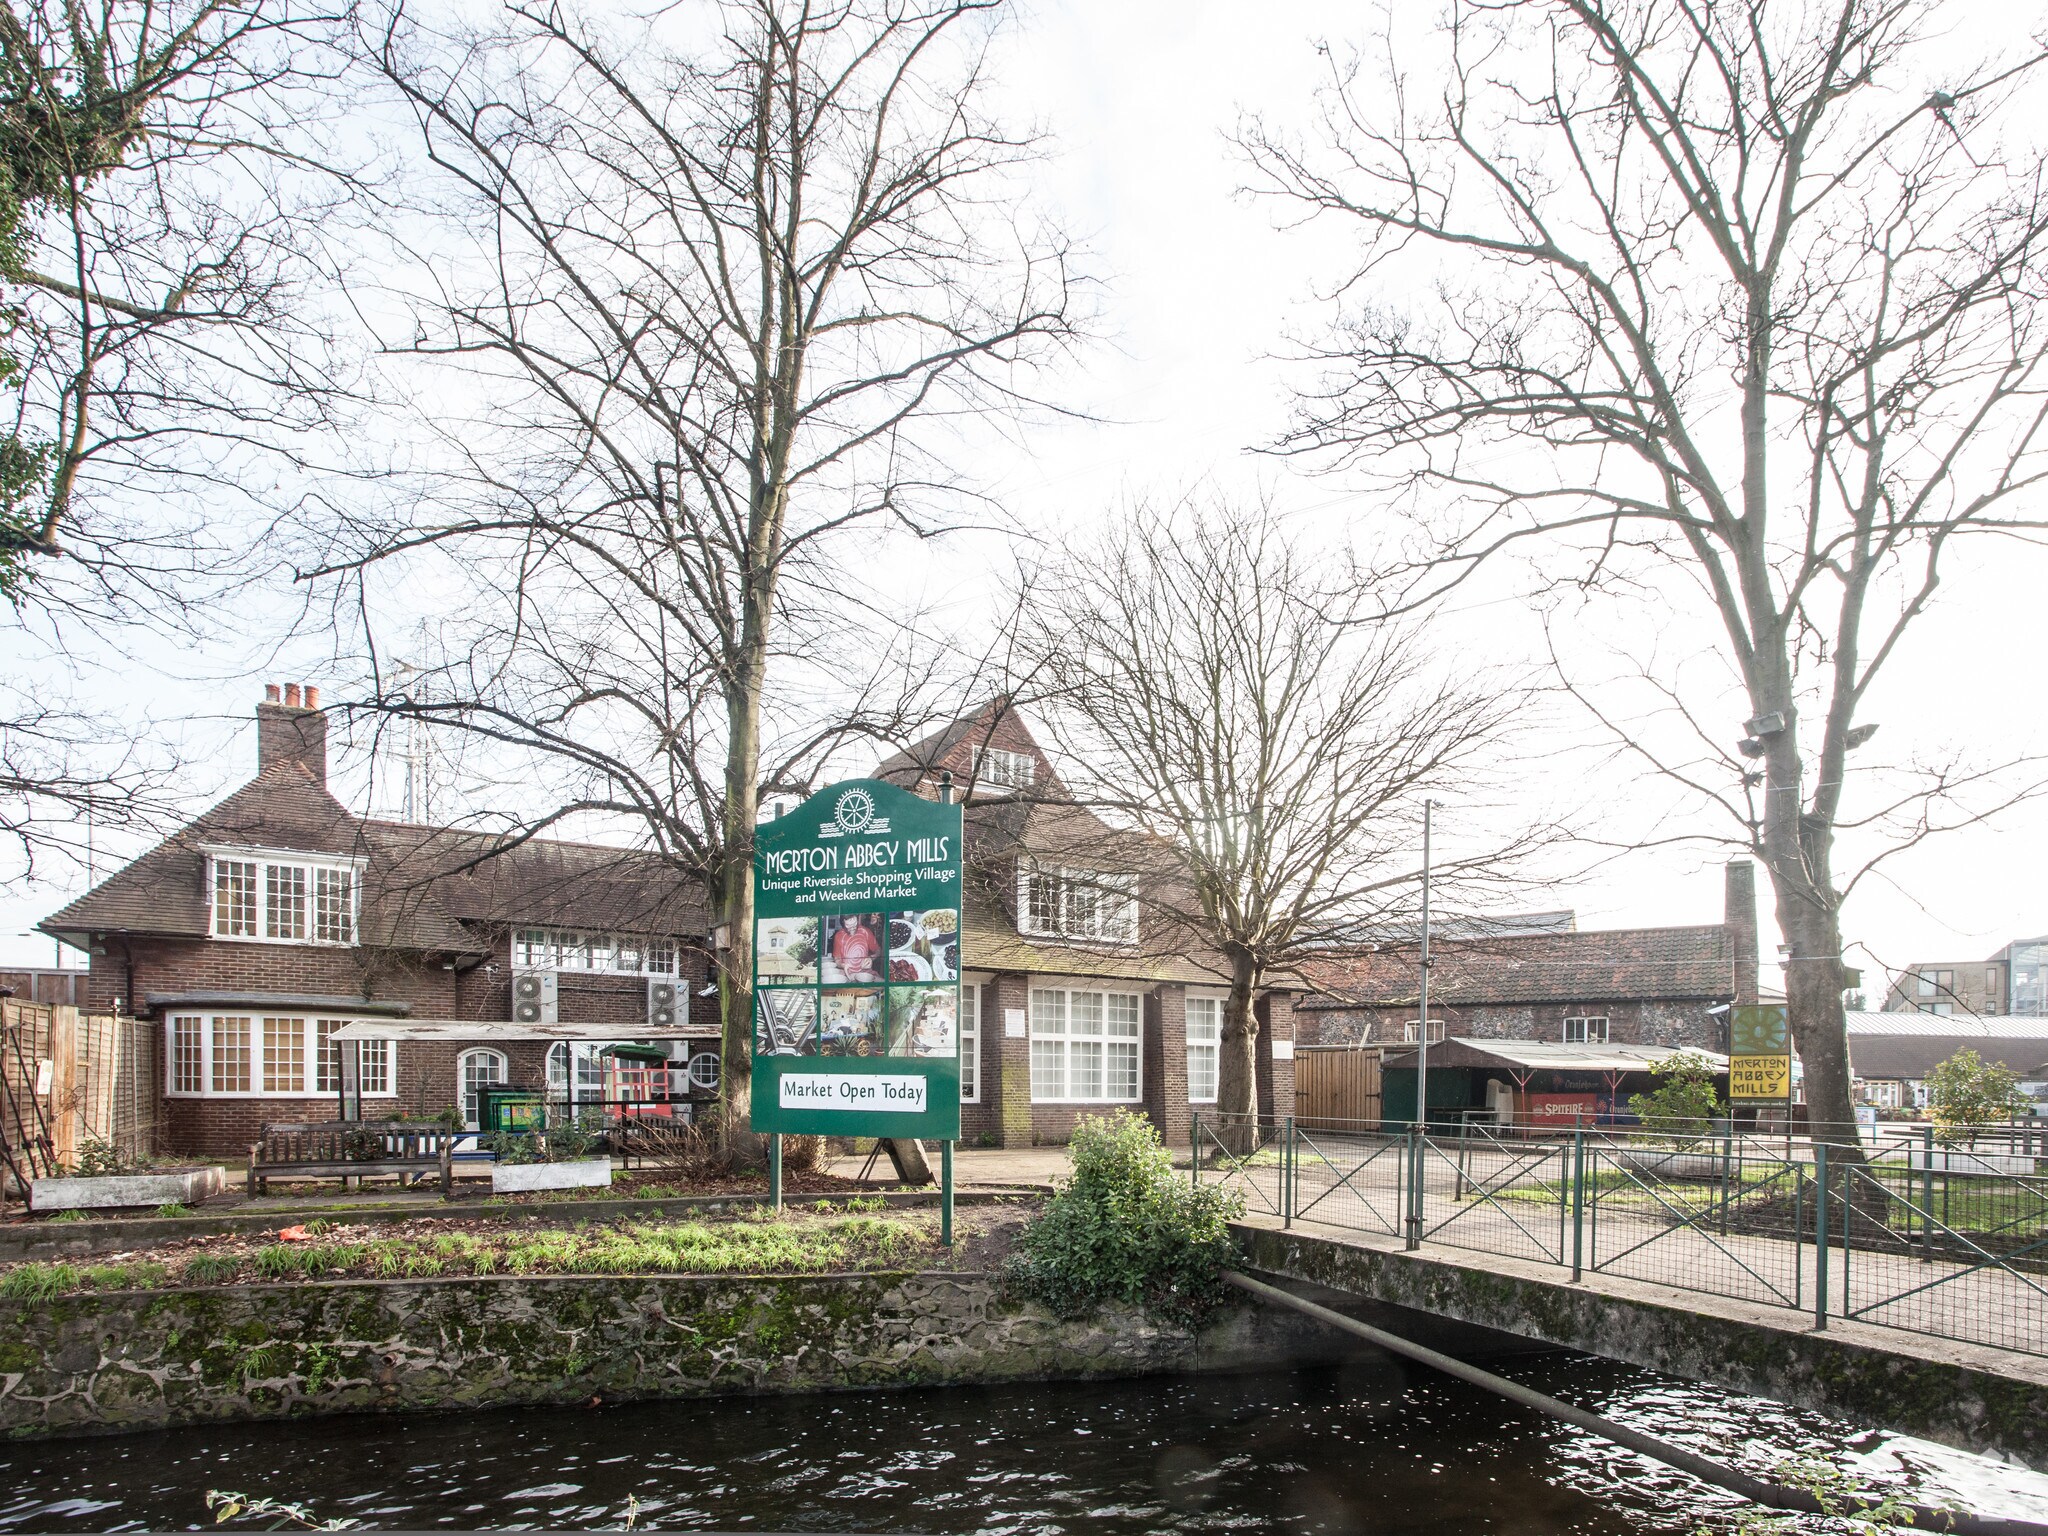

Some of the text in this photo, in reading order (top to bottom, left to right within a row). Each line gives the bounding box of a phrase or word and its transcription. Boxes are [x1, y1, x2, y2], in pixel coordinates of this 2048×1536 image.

[766, 836, 949, 874] MERTON ABBEY MILLS
[762, 867, 956, 892] Unique Riverside Shopping Village
[795, 885, 917, 903] and Weekend Market
[1733, 1059, 1786, 1068] MERTON
[1732, 1071, 1786, 1080] ABBEY
[784, 1080, 923, 1105] Market Open Today
[1733, 1084, 1778, 1093] MILLS
[1545, 1103, 1583, 1116] SPITFIRE
